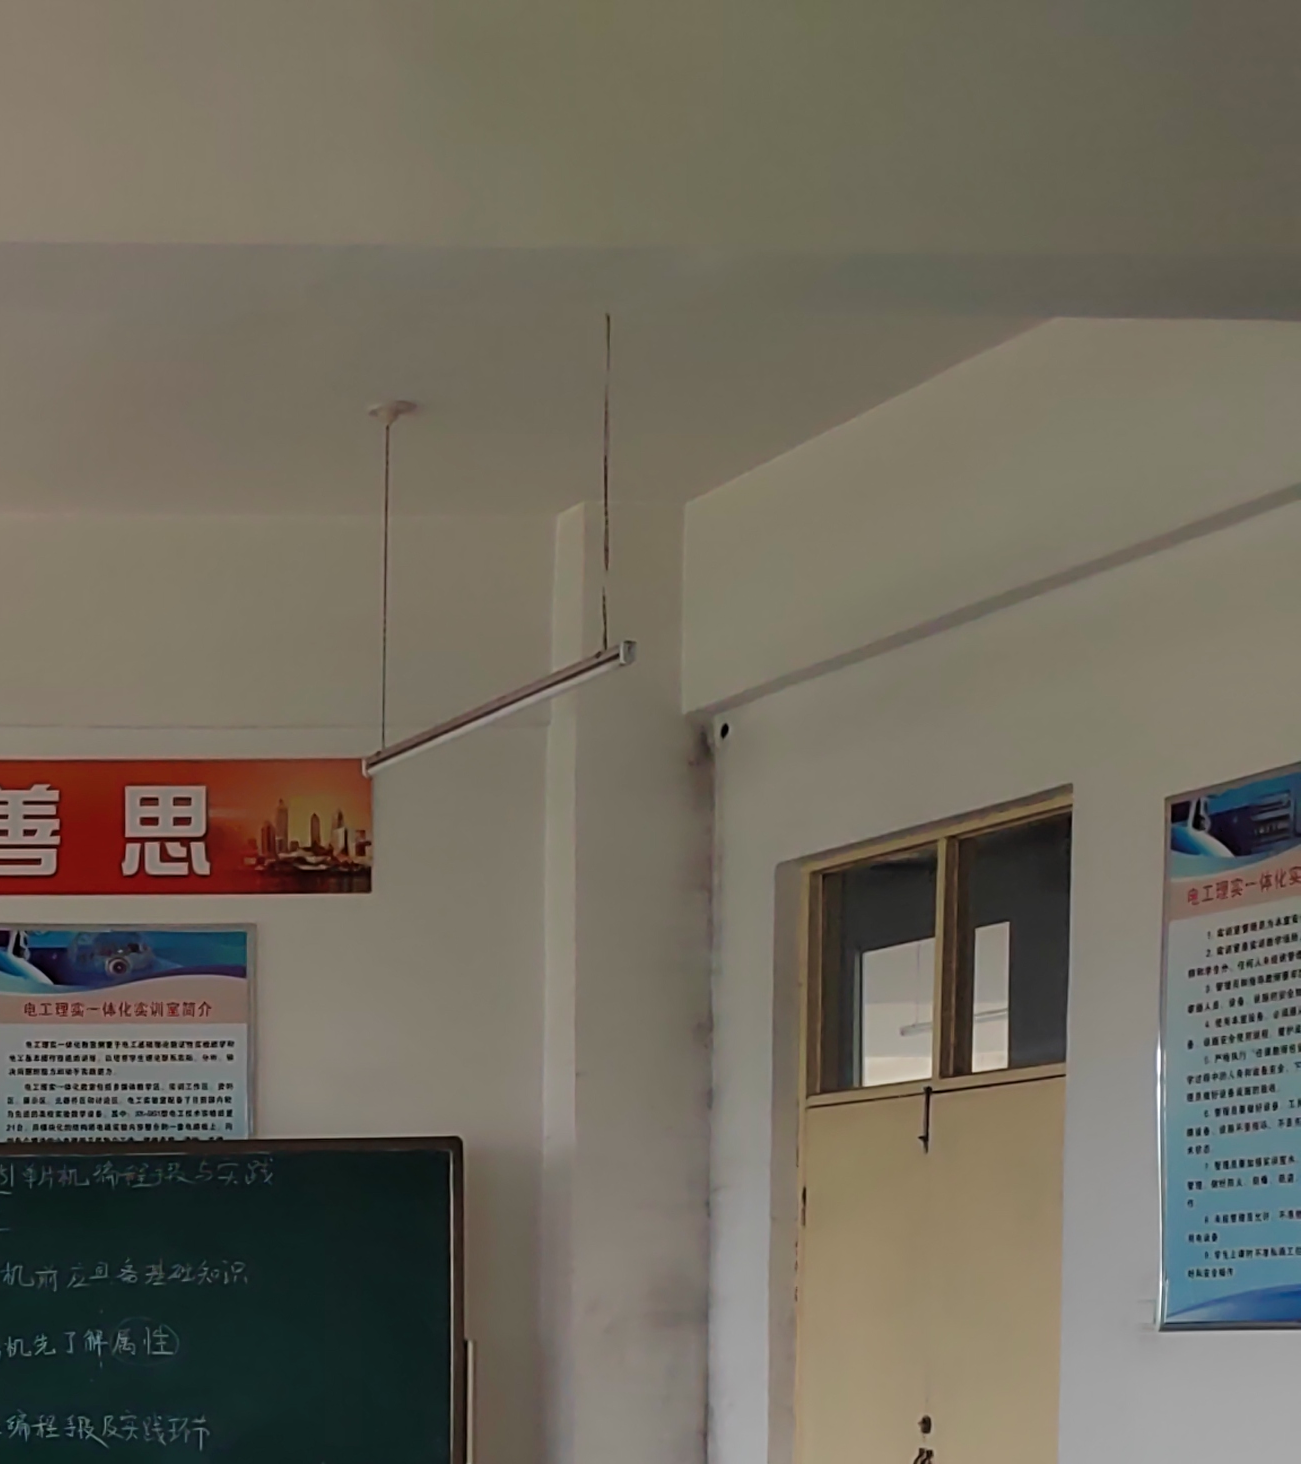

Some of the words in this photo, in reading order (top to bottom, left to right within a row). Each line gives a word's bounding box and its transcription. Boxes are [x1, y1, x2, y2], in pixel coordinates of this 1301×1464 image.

[24, 1001, 212, 1018] 电工理实一体化实训室简介
